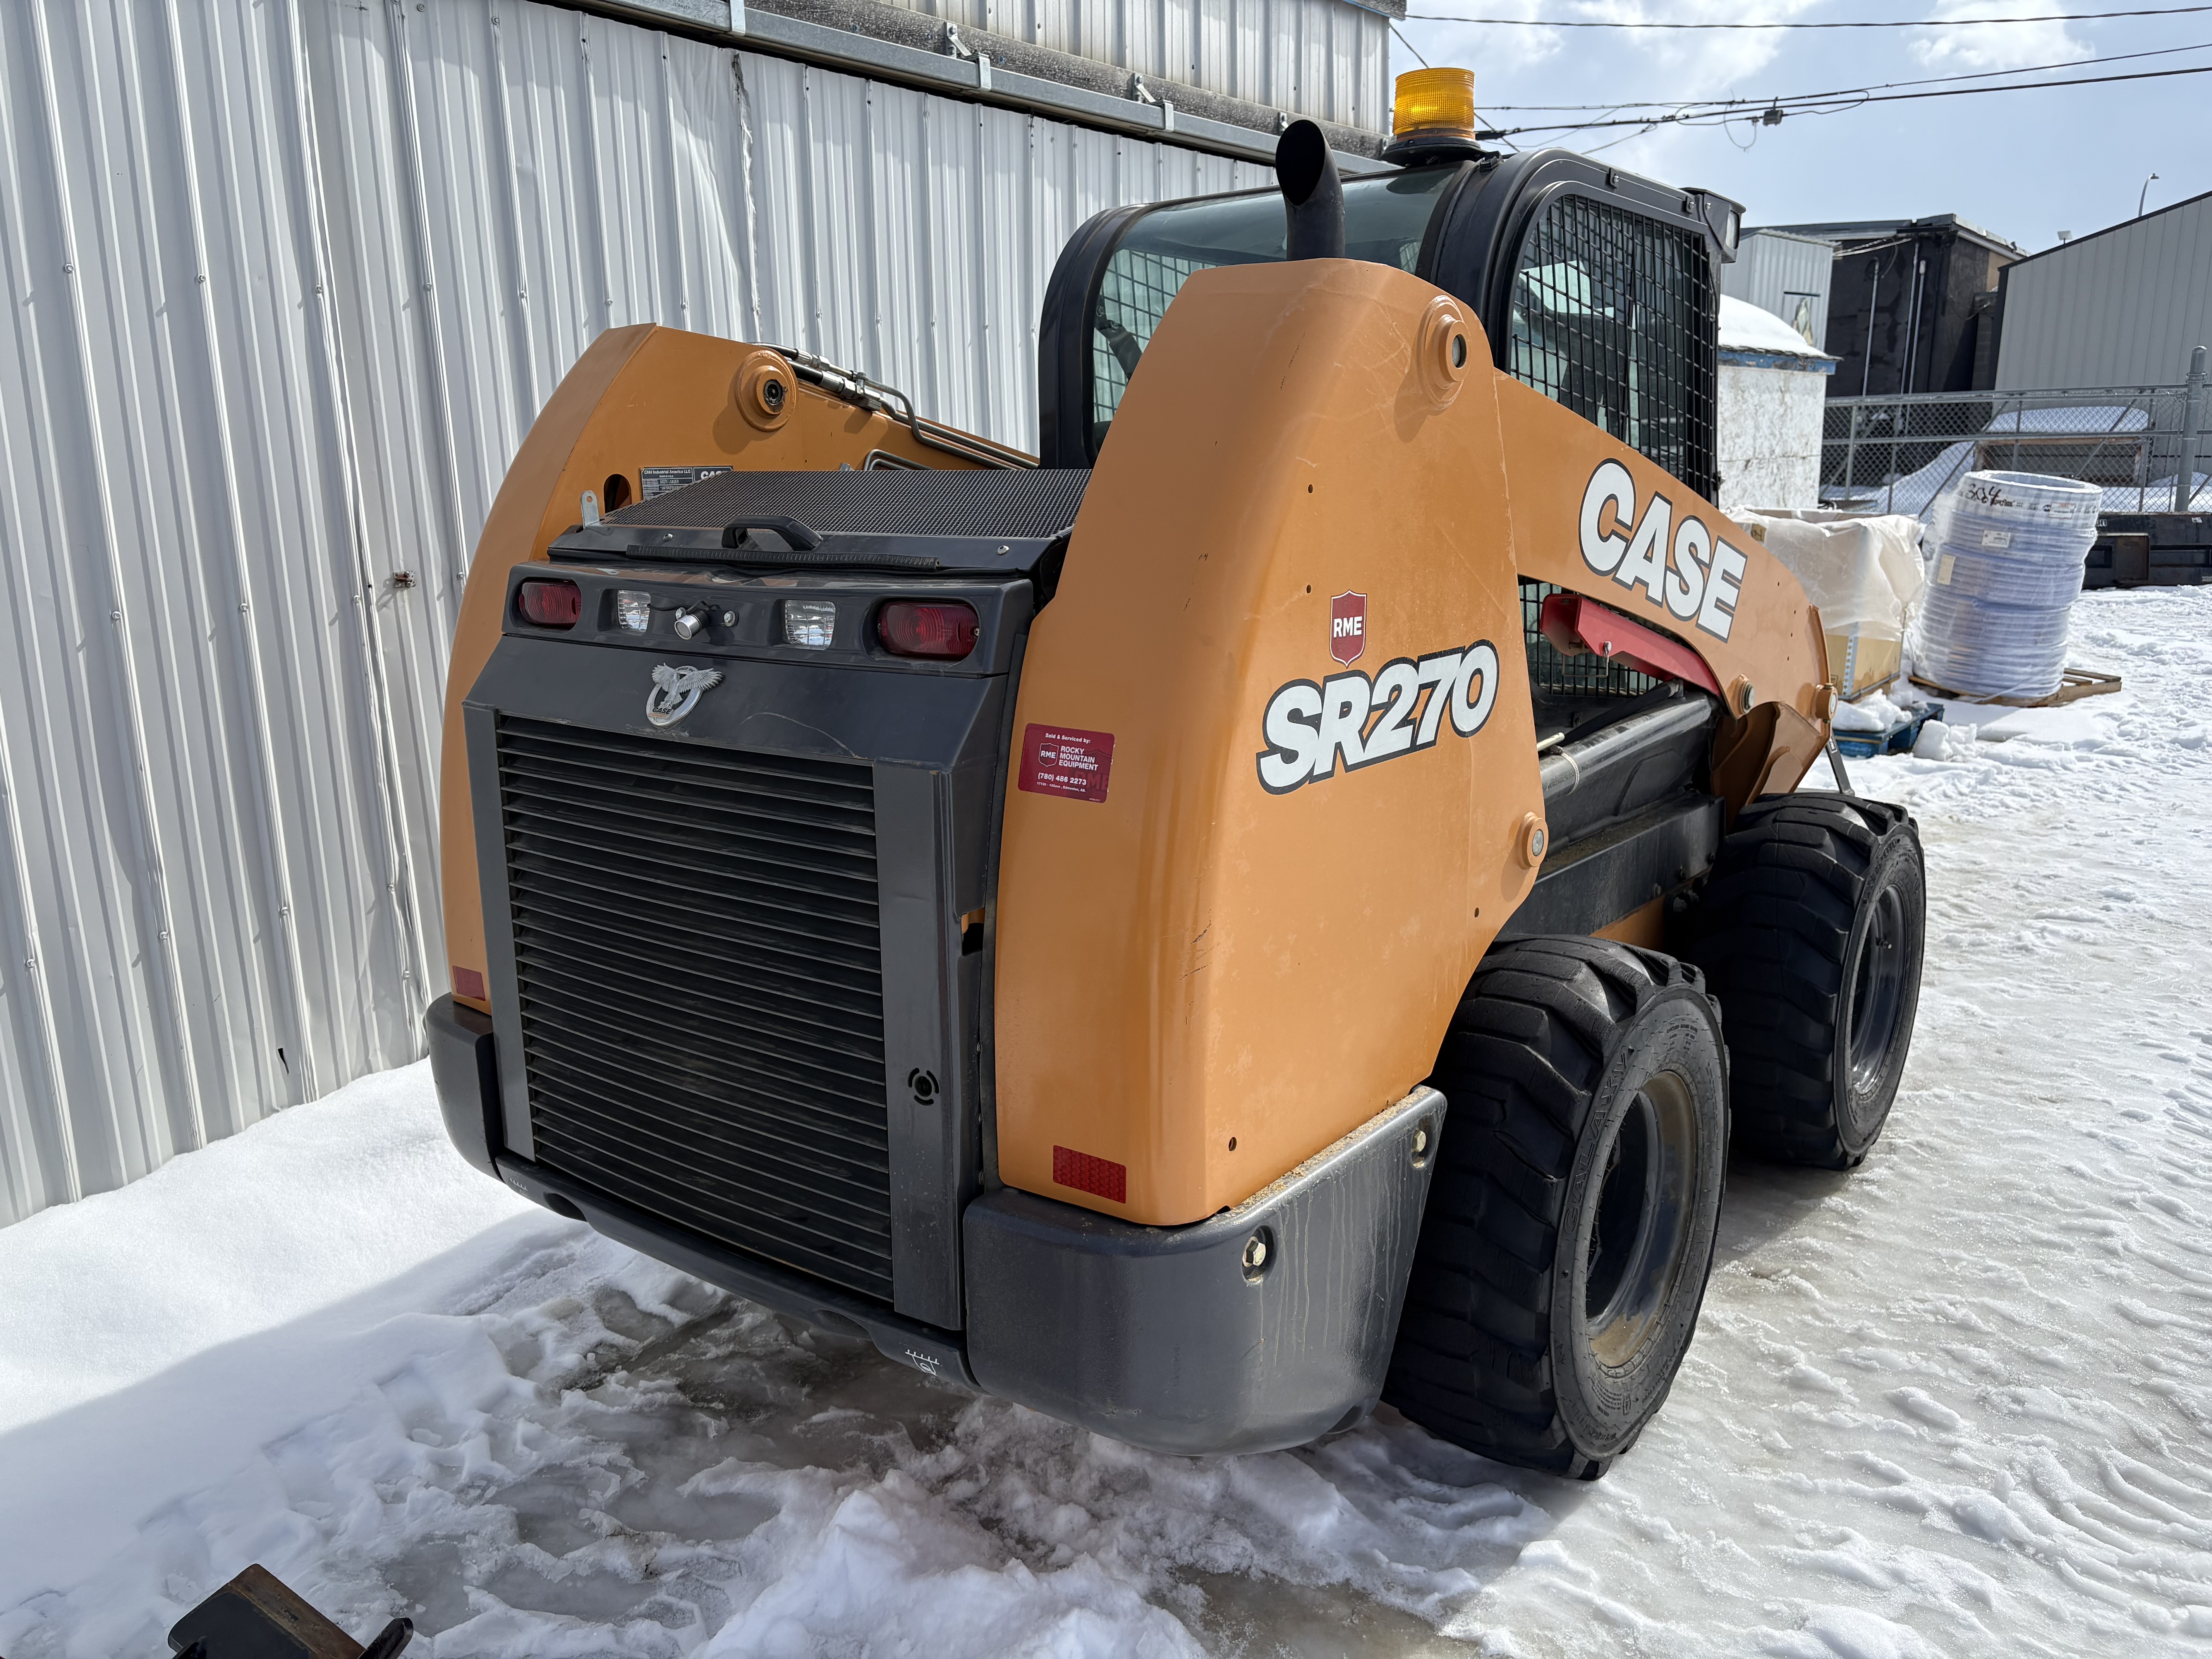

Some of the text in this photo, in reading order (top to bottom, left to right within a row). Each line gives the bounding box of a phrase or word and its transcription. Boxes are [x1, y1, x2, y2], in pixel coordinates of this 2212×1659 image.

[1578, 458, 1748, 644] CASE
[1333, 616, 1363, 638] RME
[1256, 639, 1500, 796] SR270
[1041, 750, 1056, 759] RME
[1061, 745, 1085, 755] ROCKY
[1060, 752, 1095, 763] MOUNTAIN
[1059, 759, 1099, 771] EQUIPMENT
[1038, 772, 1054, 781] (780)
[1070, 777, 1087, 785] 2273
